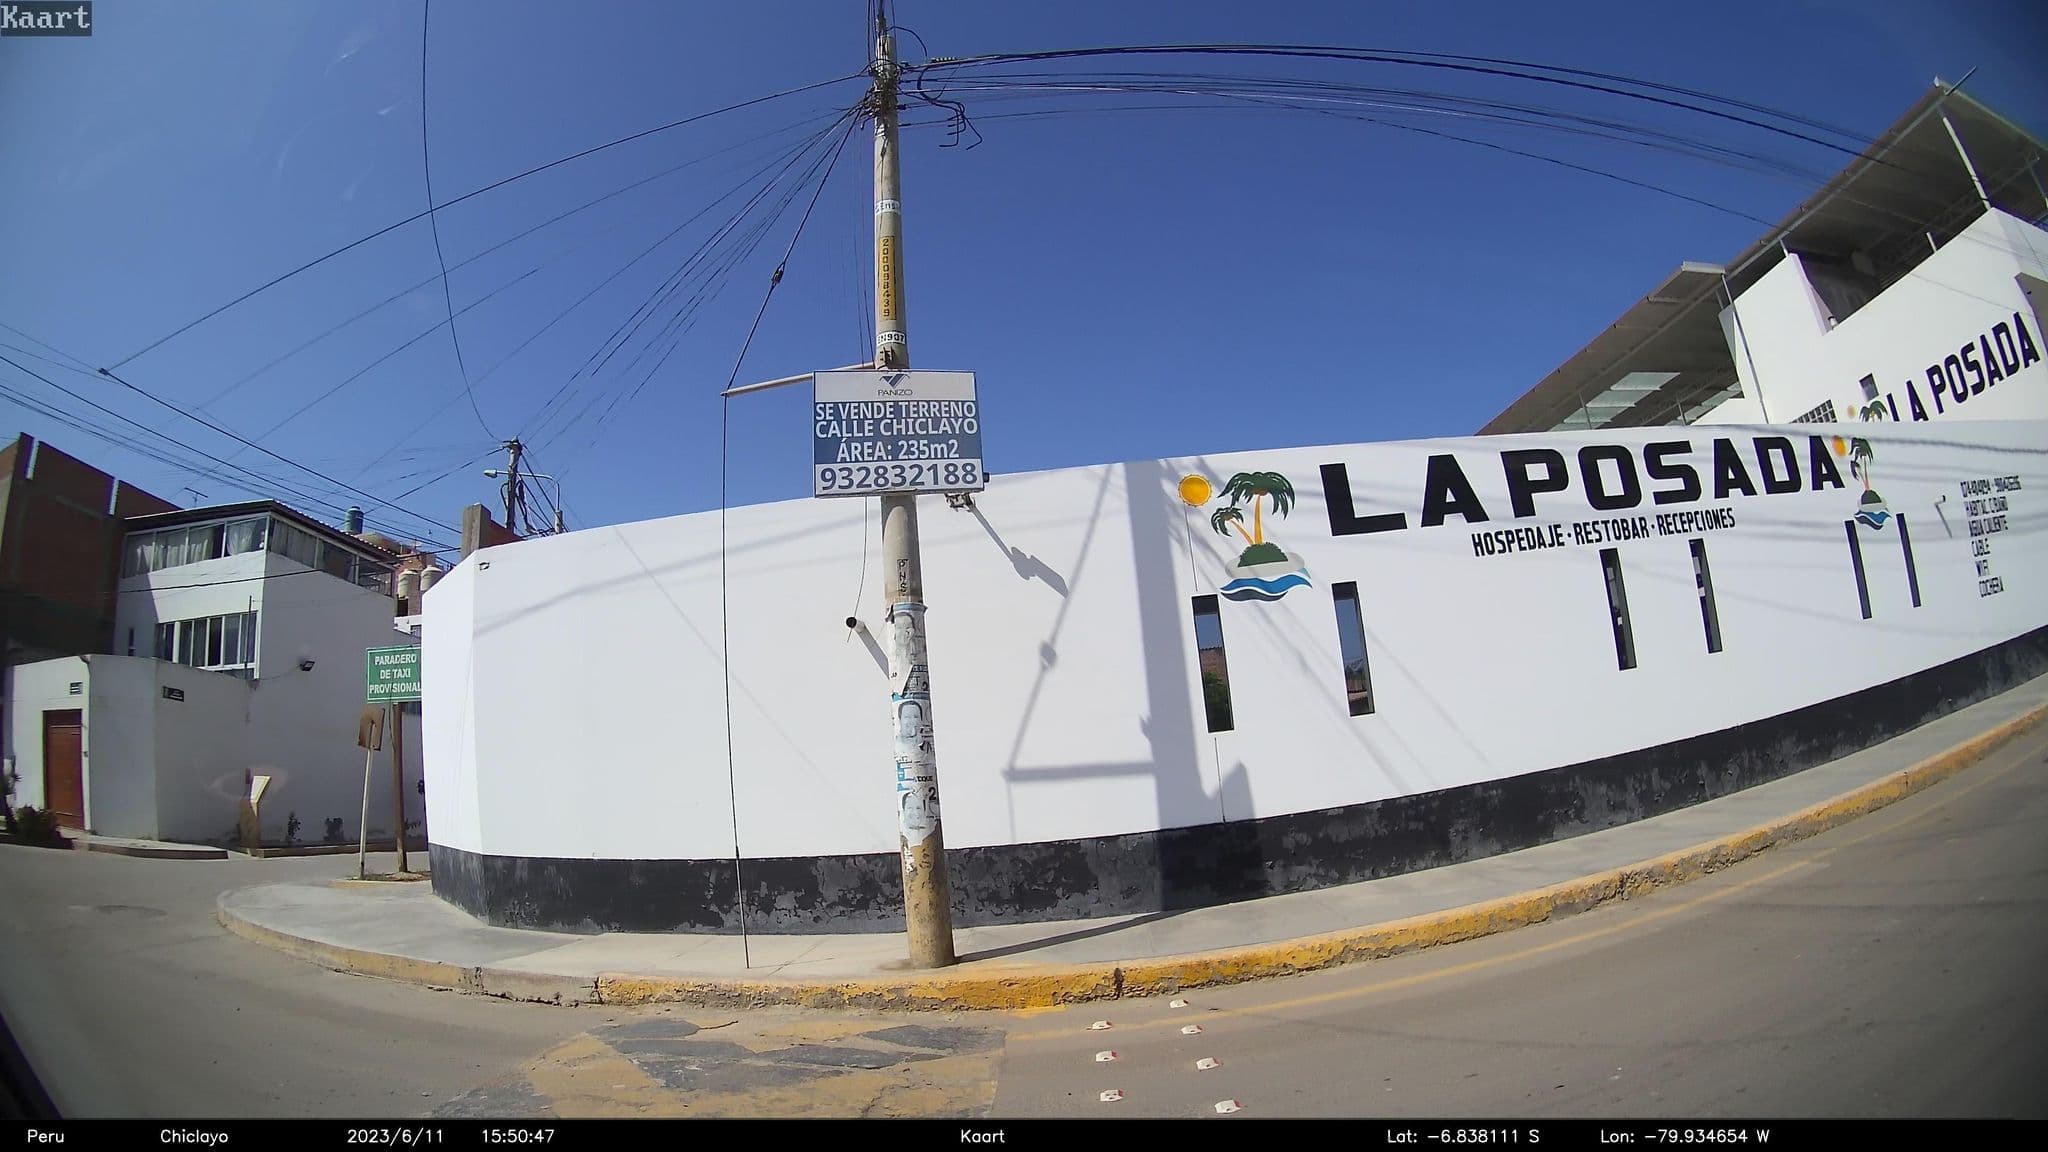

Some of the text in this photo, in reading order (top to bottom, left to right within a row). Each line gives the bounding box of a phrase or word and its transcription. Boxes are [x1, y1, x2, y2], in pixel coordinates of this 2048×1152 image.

[1925, 311, 2041, 415] POSADA
[877, 388, 914, 397] PANIZO
[815, 401, 976, 421] SE VENDE TERRENO
[815, 417, 978, 438] CALLE CHICLAYO
[836, 437, 960, 463] ÁREA: 235m2
[820, 462, 978, 491] 932832188
[1319, 434, 1846, 537] LA POSADA
[1470, 506, 1736, 558] HOSPEDAJE RESTOBAR RECEPCIONES
[374, 653, 417, 666] PARADERO
[380, 668, 411, 680] DE TAXI
[369, 682, 422, 694] PROVISIONAL
